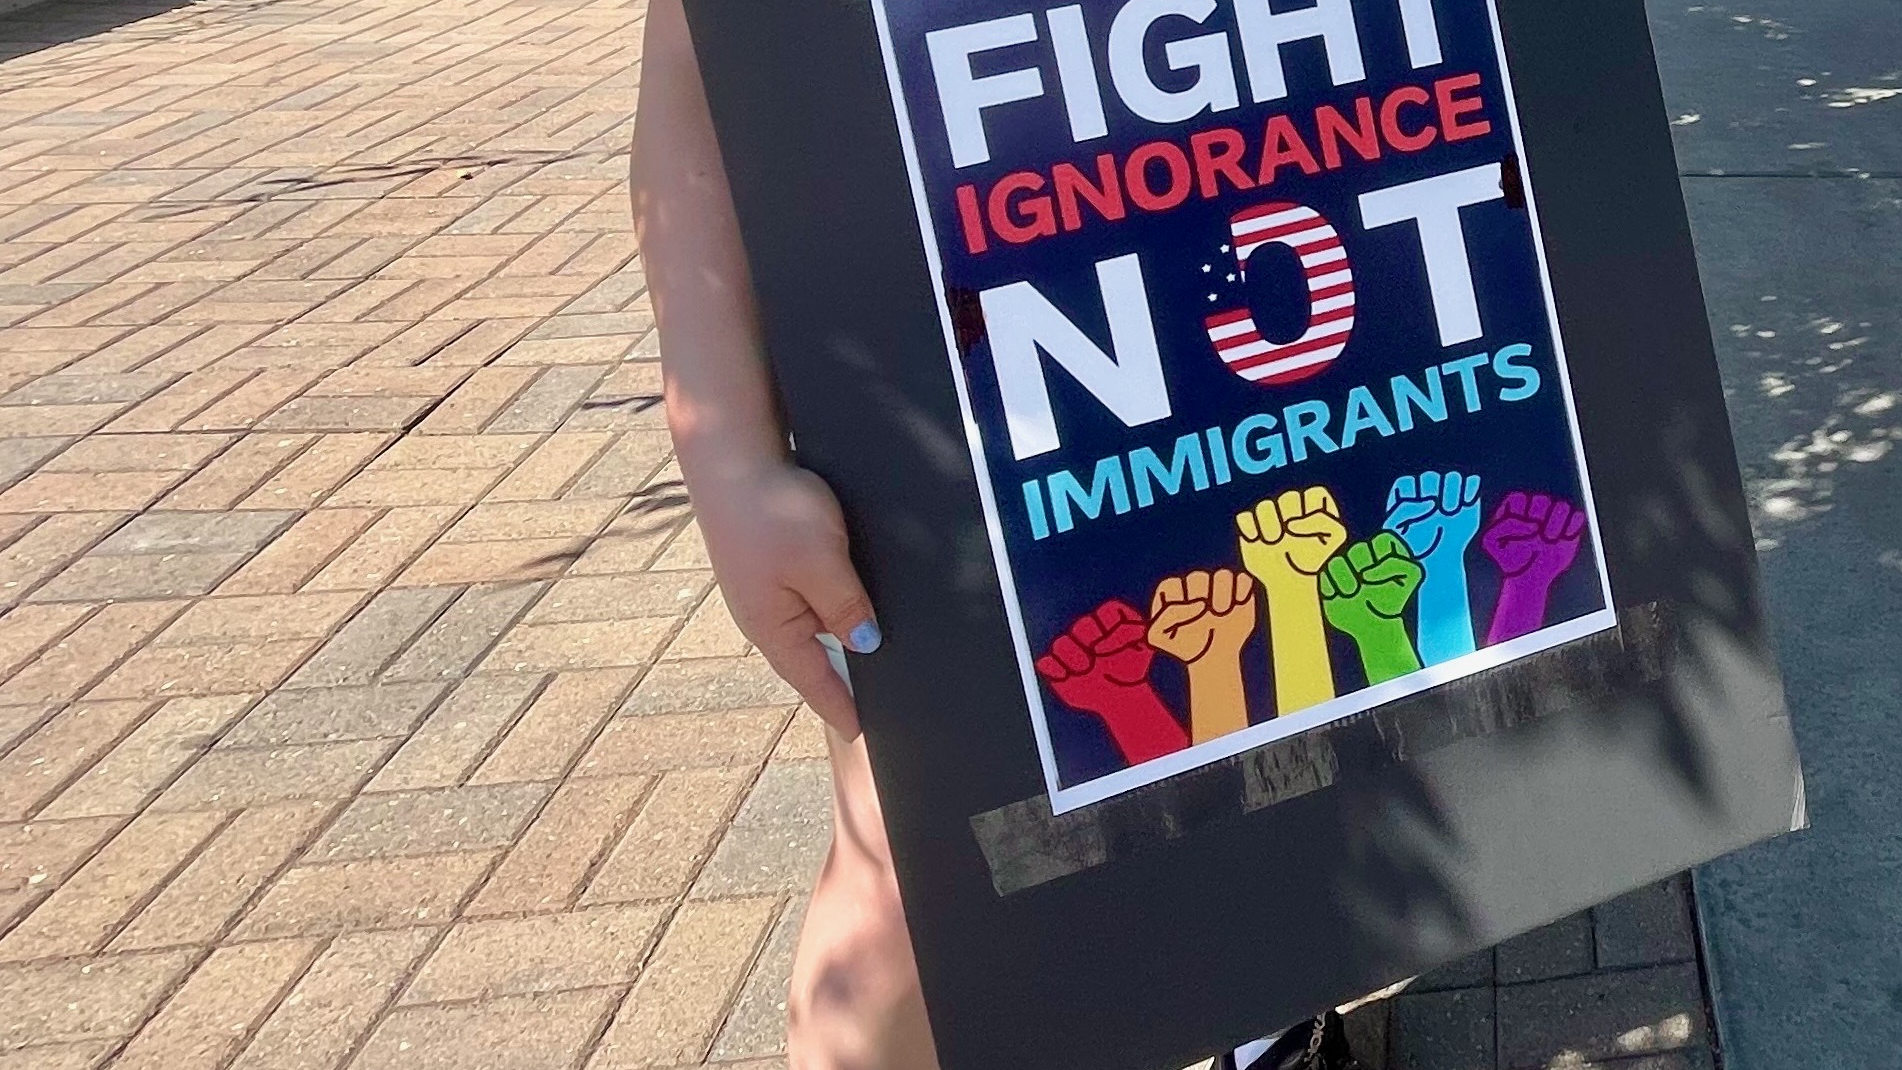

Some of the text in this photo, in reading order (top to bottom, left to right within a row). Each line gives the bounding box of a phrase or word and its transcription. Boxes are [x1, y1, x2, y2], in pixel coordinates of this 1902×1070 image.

[955, 72, 1492, 255] IGNORANCE
[978, 162, 1506, 461] NOT
[1021, 341, 1542, 541] IMMIGRANTS
